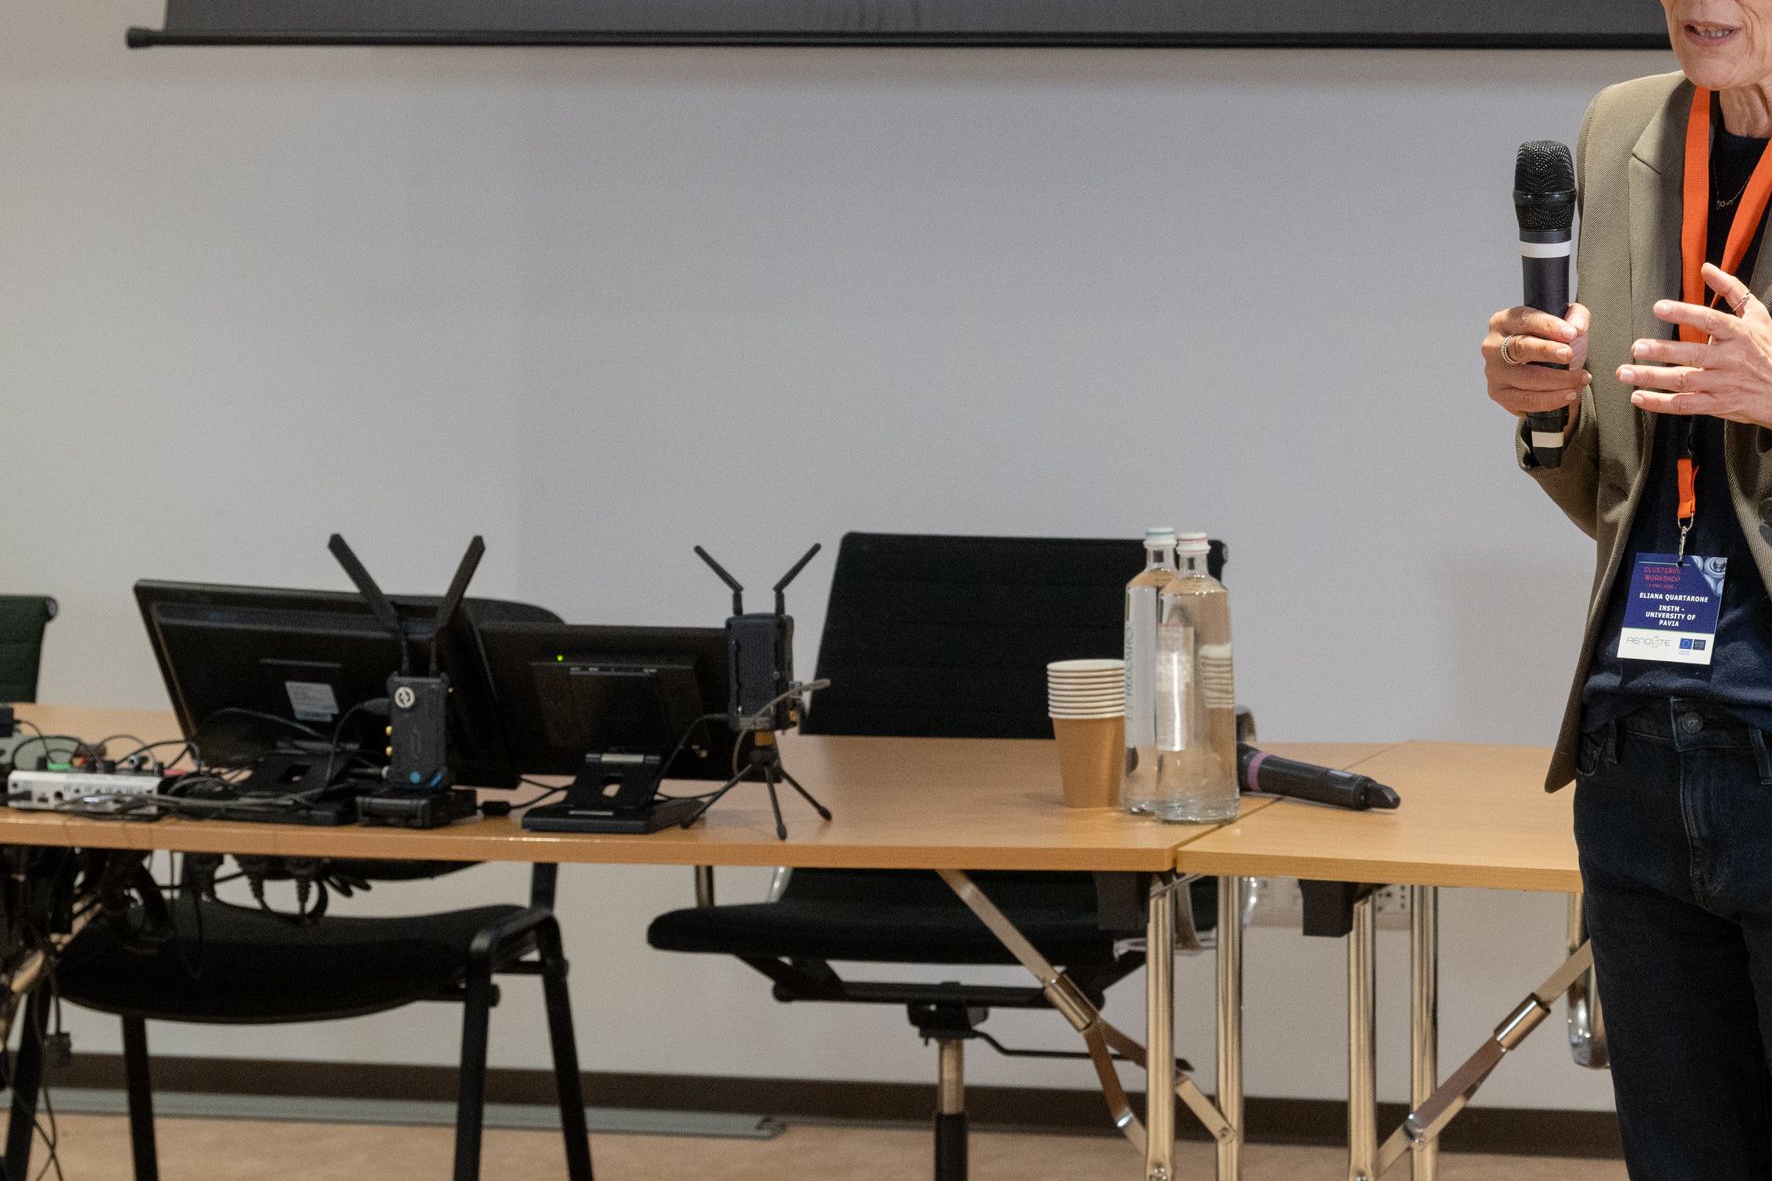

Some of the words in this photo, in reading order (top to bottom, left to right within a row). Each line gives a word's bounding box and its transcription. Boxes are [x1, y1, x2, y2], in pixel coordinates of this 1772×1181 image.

[1639, 592, 1664, 600] ELIANA
[1664, 594, 1709, 603] QUARTARONE
[1645, 612, 1685, 620] UNIVERSITY
